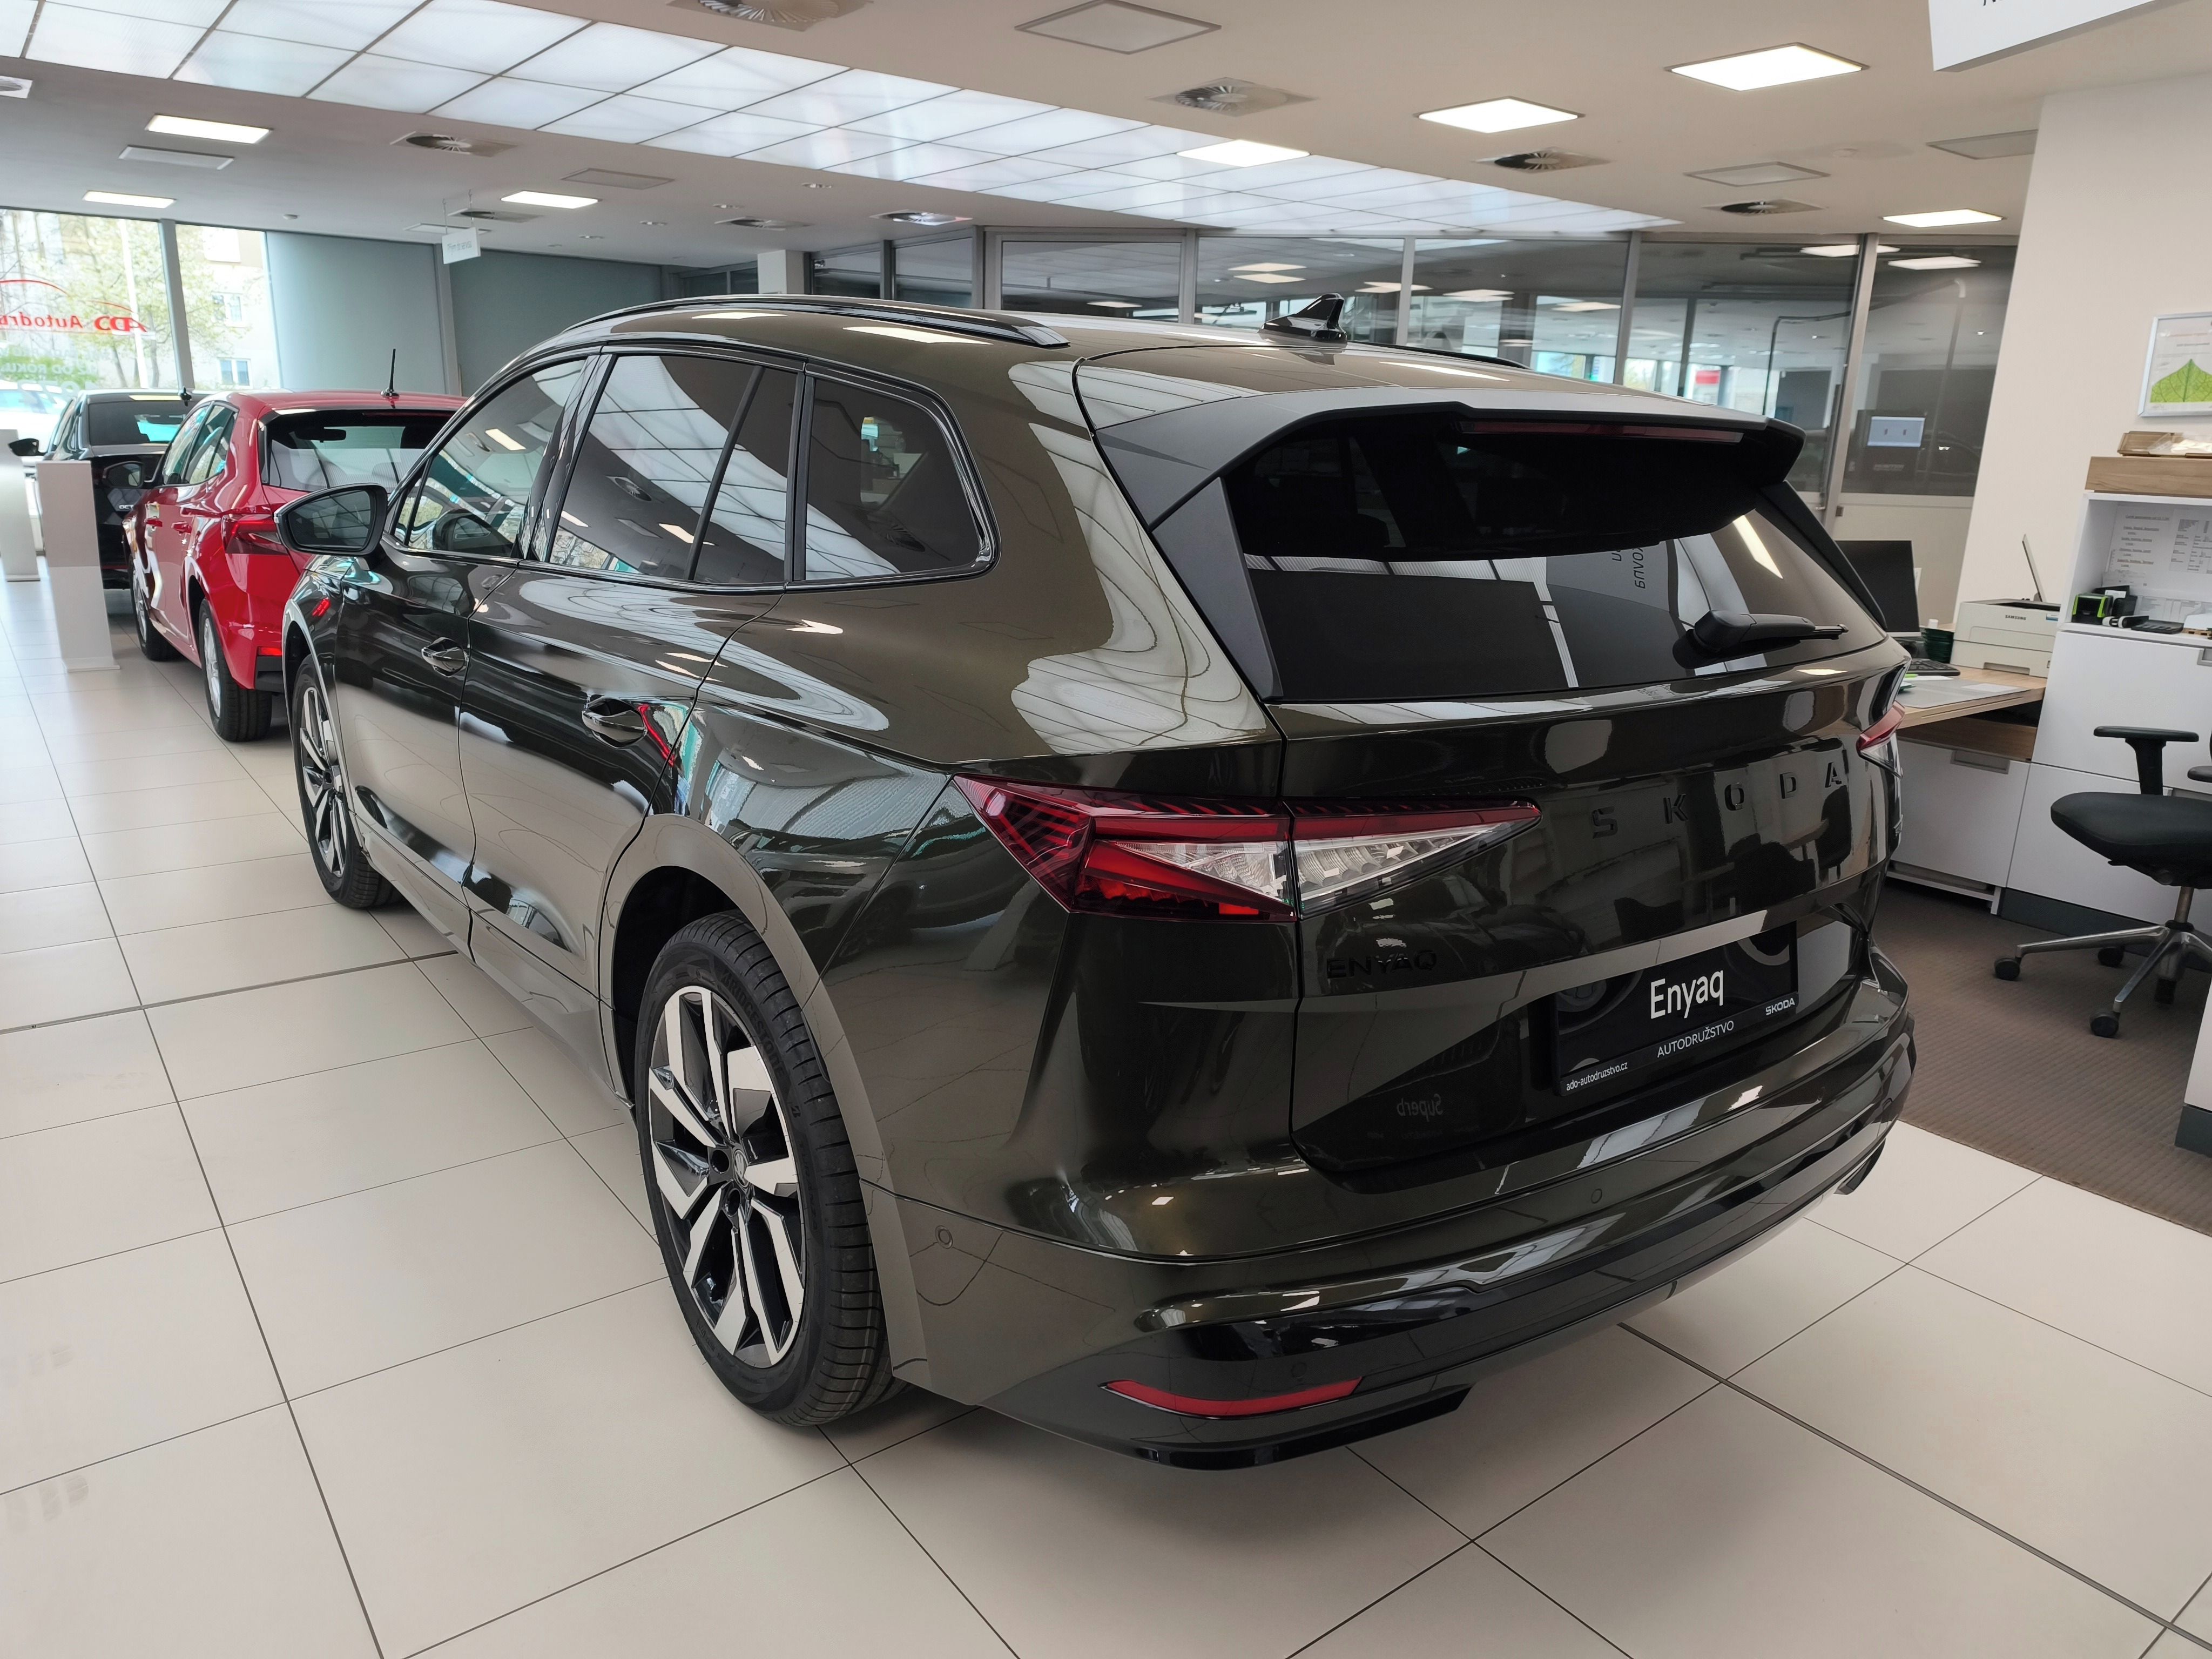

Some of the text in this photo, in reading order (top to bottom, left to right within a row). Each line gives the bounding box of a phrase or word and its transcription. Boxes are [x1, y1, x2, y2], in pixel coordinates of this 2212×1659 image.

[1326, 949, 1437, 979] ENYAQ
[1650, 970, 1724, 1019] Enyaq
[1657, 1020, 1735, 1058] AUTODRUŽSTVO
[1566, 1062, 1628, 1091] ado-autodruzstvo.cz
